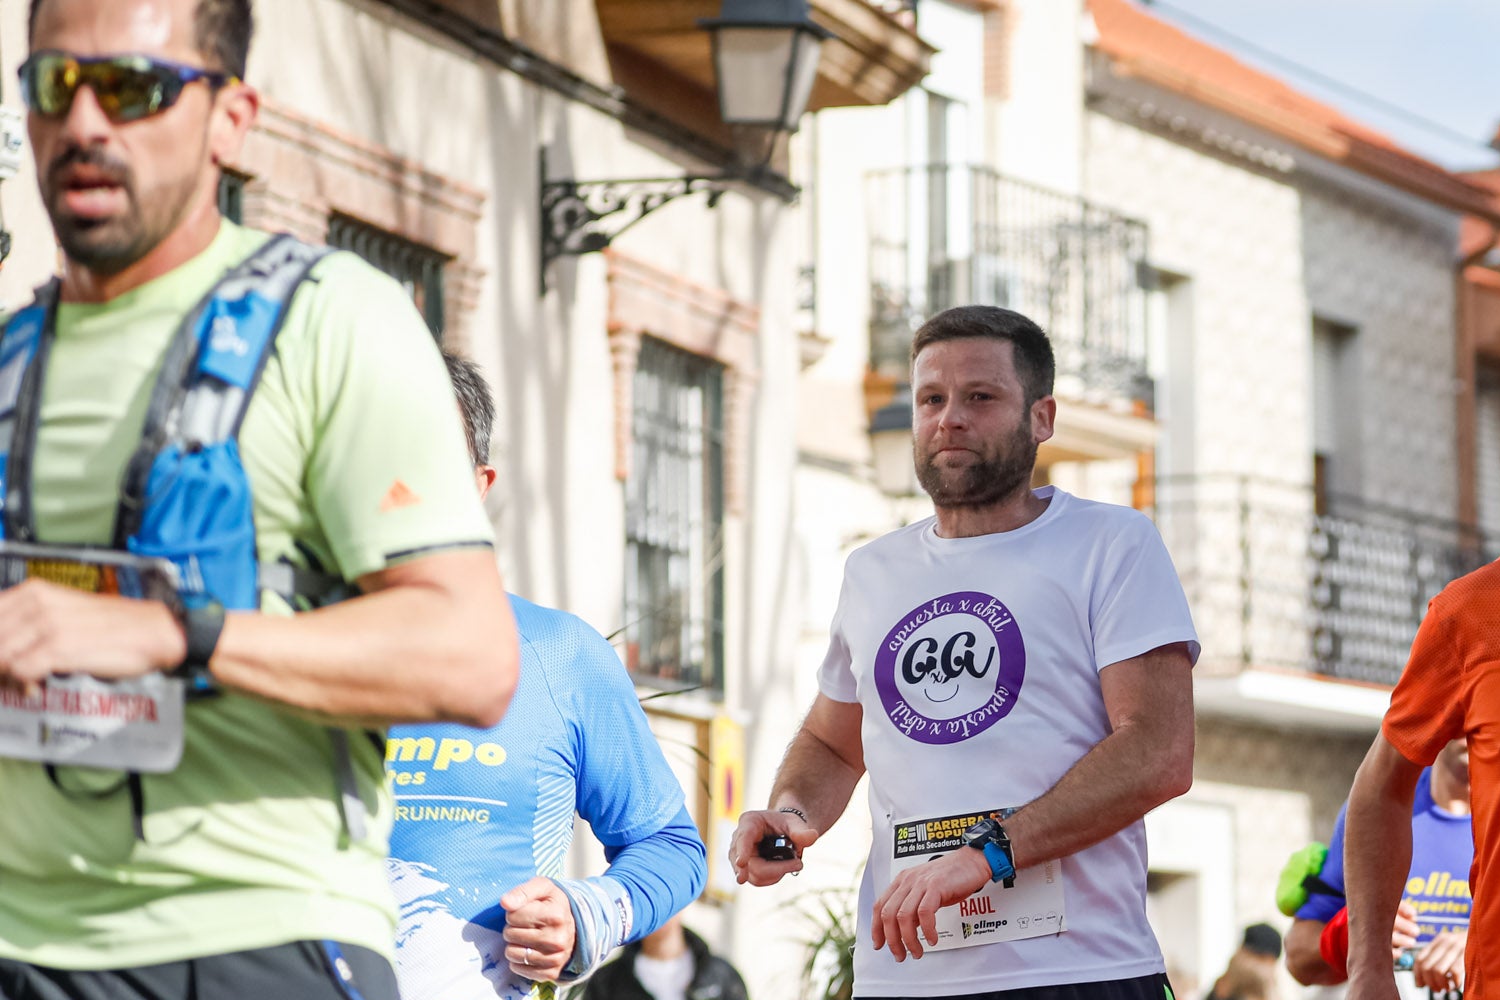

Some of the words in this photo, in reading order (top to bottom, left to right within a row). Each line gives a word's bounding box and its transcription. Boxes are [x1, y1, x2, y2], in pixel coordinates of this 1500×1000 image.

[889, 599, 954, 651] apuesta
[958, 599, 971, 611] x
[973, 598, 1012, 632] abril
[395, 805, 490, 823] RUNNING
[897, 827, 908, 840] 26
[926, 815, 984, 832] CARRERA
[916, 843, 925, 851] los
[926, 839, 960, 849] Secaderos
[959, 896, 996, 917] RAUL
[974, 919, 1008, 931] olimpo
